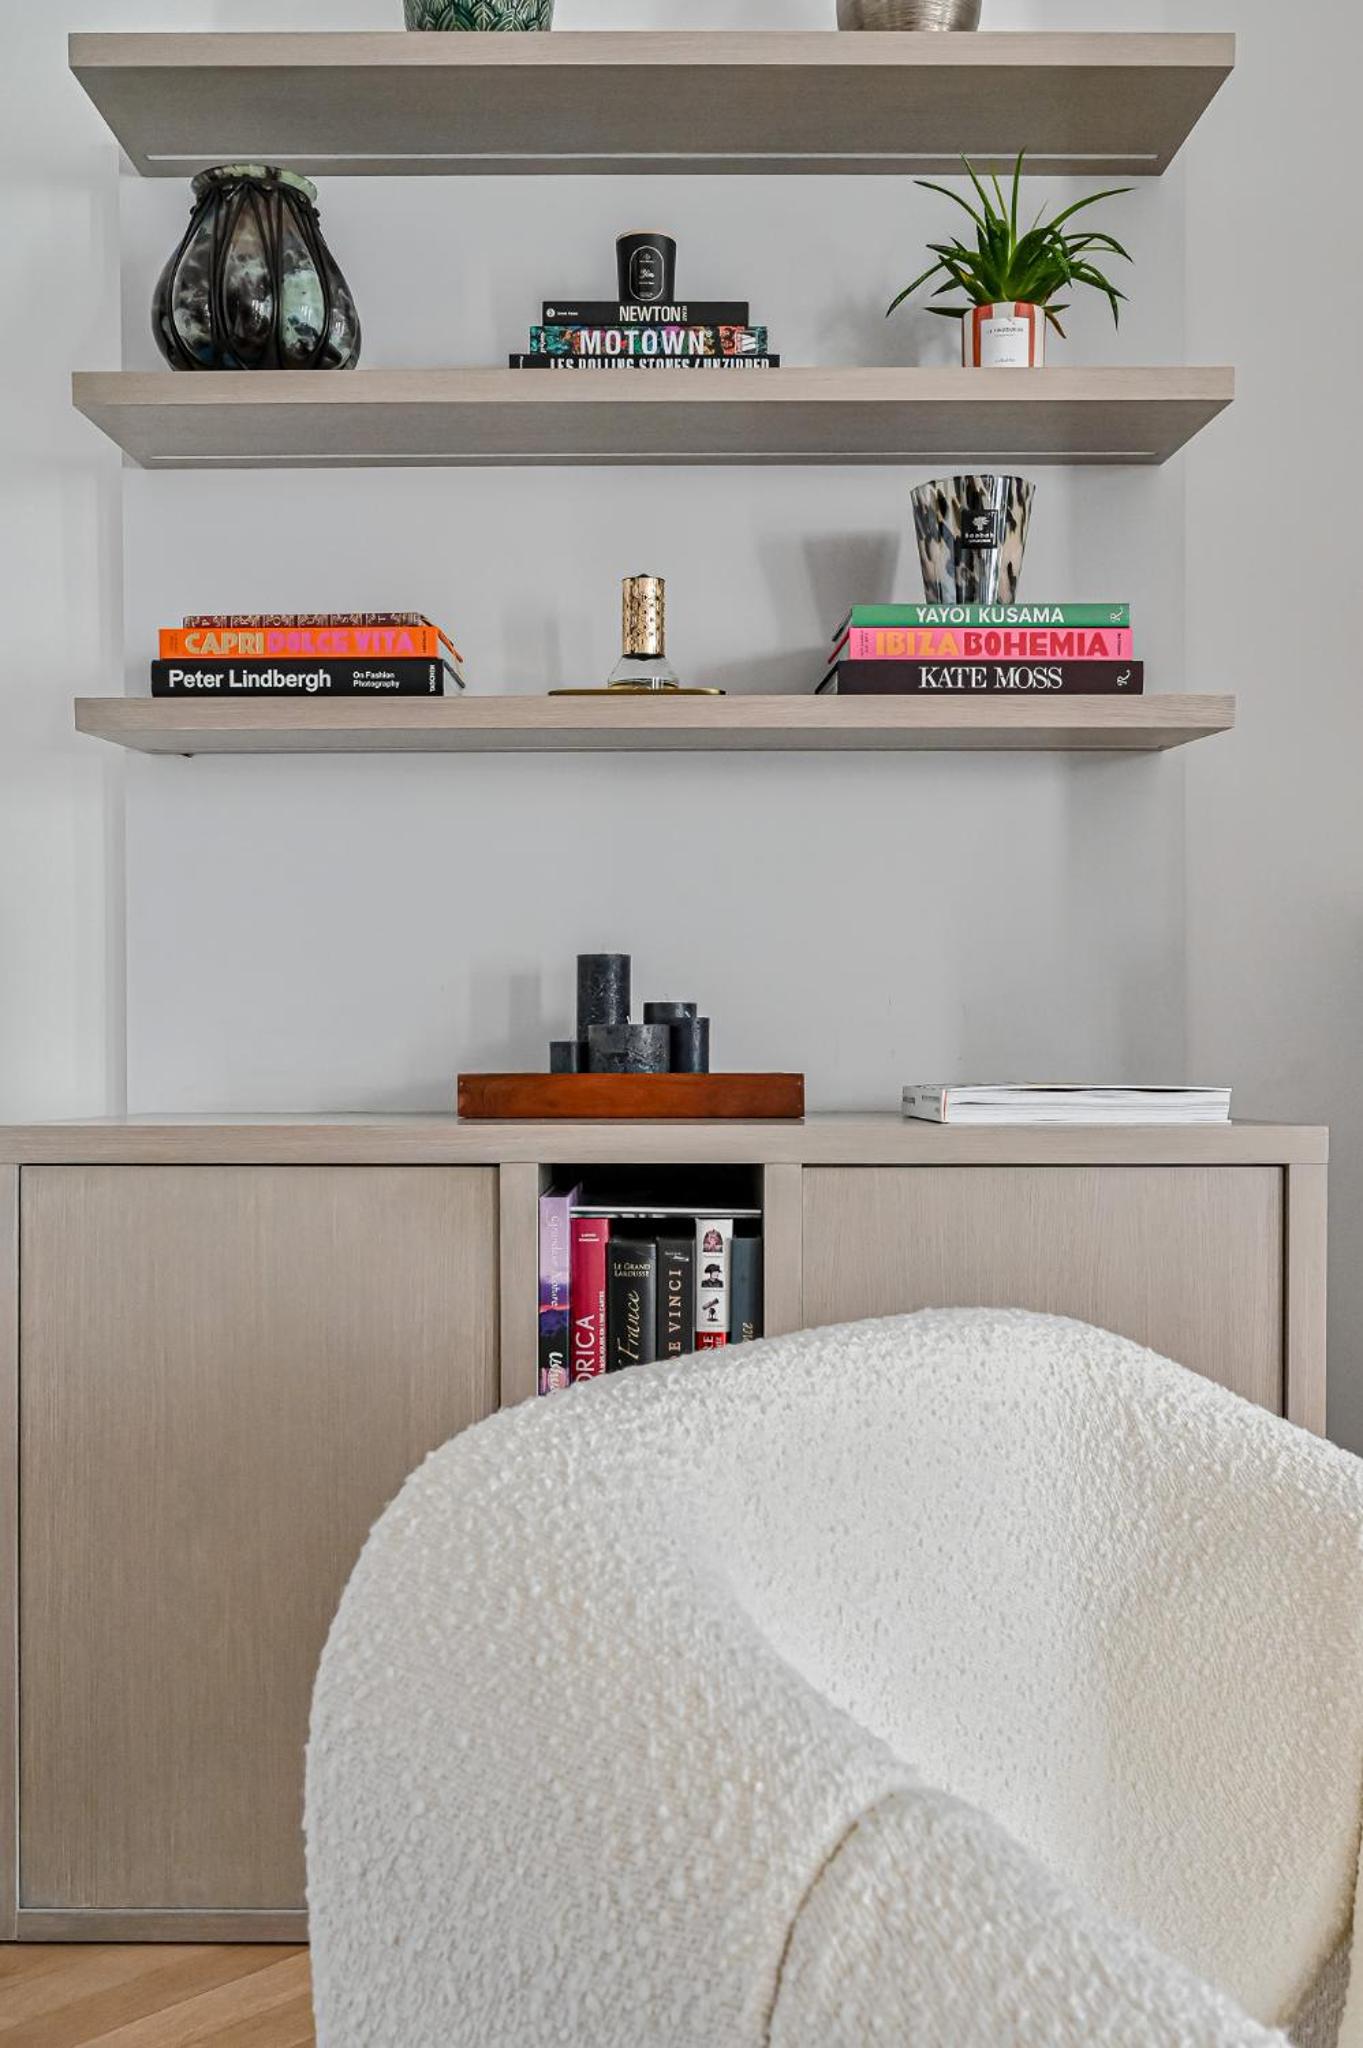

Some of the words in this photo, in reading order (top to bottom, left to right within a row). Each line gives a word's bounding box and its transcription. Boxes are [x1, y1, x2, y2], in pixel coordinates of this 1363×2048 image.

[620, 305, 681, 321] NEWTON
[579, 330, 705, 355] MOTOWN
[916, 607, 971, 623] YAYOI
[978, 607, 1065, 623] KUSAMA
[185, 631, 264, 655] CAPRI
[268, 631, 350, 654] DOLCE
[354, 631, 415, 654] VITA
[875, 631, 960, 656] IBIZA
[963, 631, 1110, 657] BOHEMIA
[168, 670, 225, 688] Peter
[229, 668, 332, 692] Lindbergh
[353, 671, 364, 679] On
[366, 671, 395, 679] Fashion
[353, 679, 400, 688] Photography
[918, 666, 987, 689] KATE
[993, 666, 1063, 689] MOSS
[668, 1269, 682, 1332] VINCI
[617, 1289, 640, 1359] France
